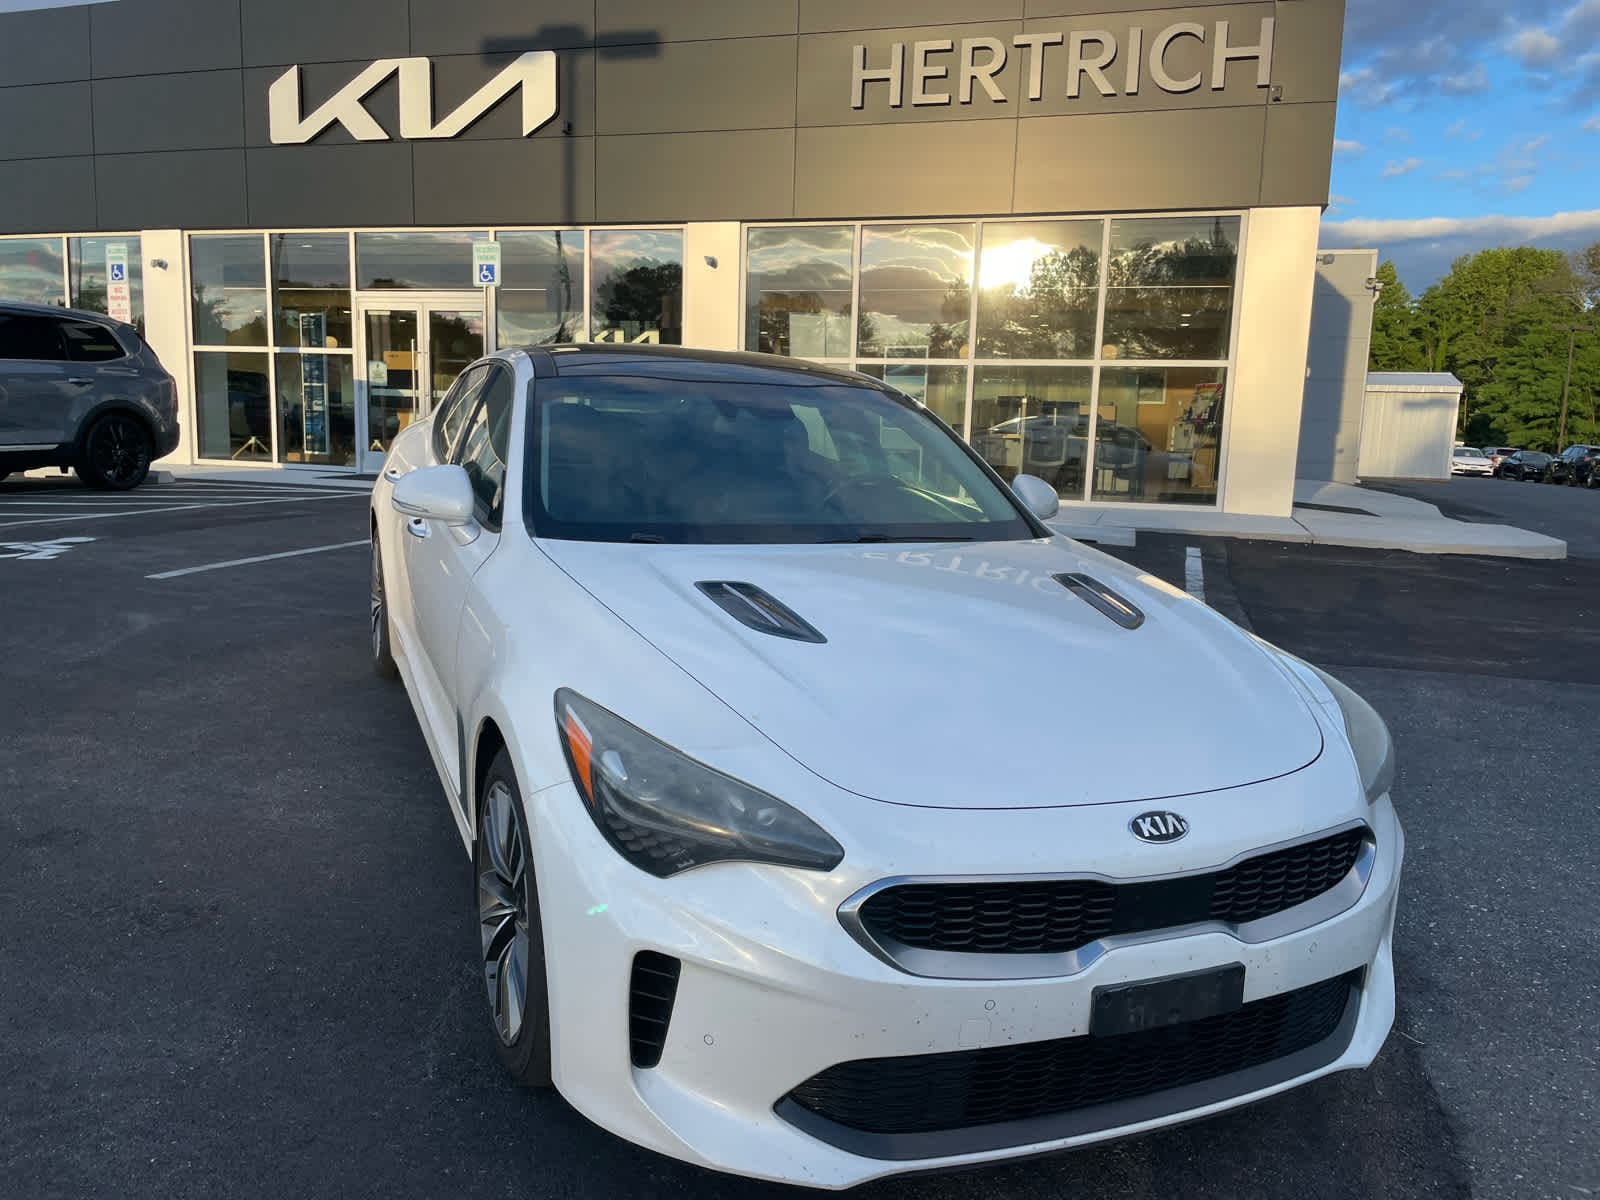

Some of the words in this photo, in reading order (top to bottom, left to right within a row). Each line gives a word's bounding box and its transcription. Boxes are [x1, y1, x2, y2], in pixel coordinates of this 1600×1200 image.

[268, 50, 558, 145] KIA
[850, 16, 1276, 110] HERTRICH
[1135, 814, 1185, 838] KIA
